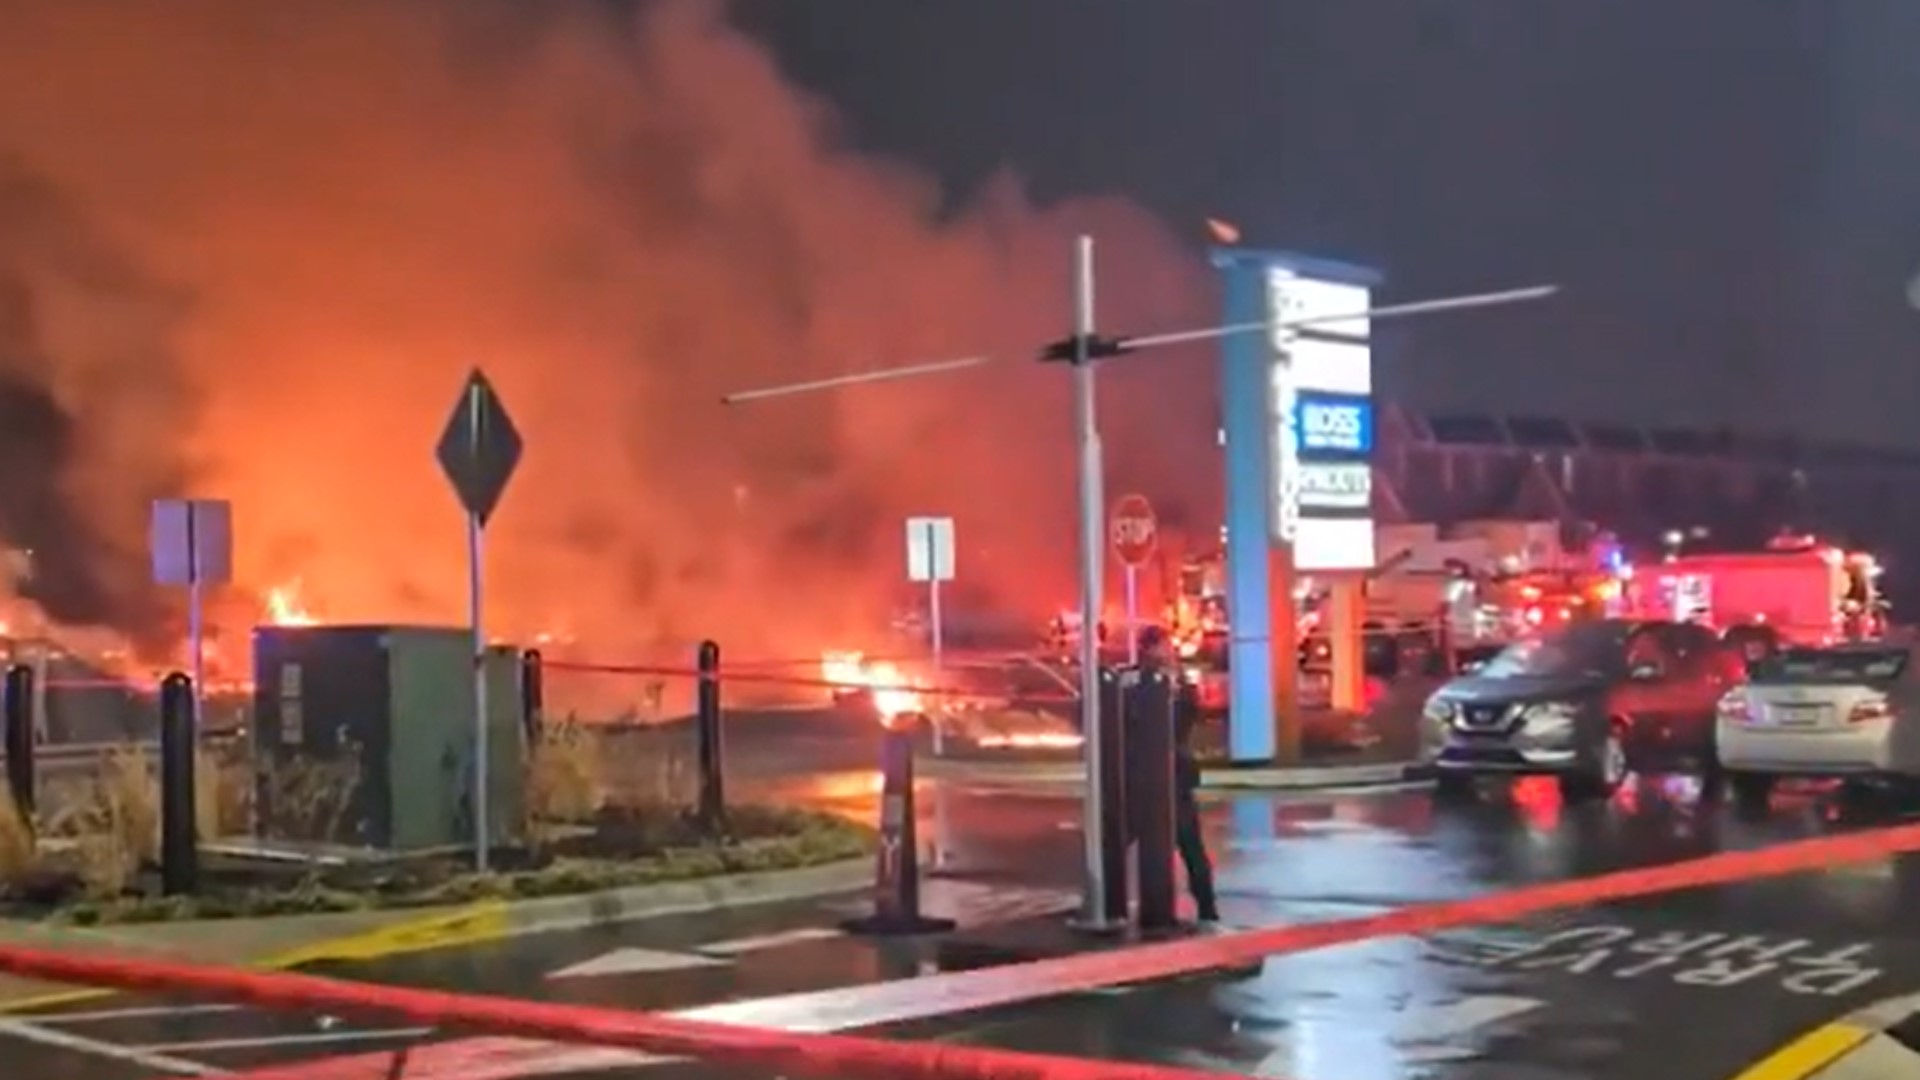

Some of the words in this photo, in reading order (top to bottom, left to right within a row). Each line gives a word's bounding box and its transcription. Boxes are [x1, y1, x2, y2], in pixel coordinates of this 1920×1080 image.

[1113, 516, 1155, 545] STOP
[1424, 932, 1881, 995] DRIVE
[1520, 926, 1875, 971] THRU
